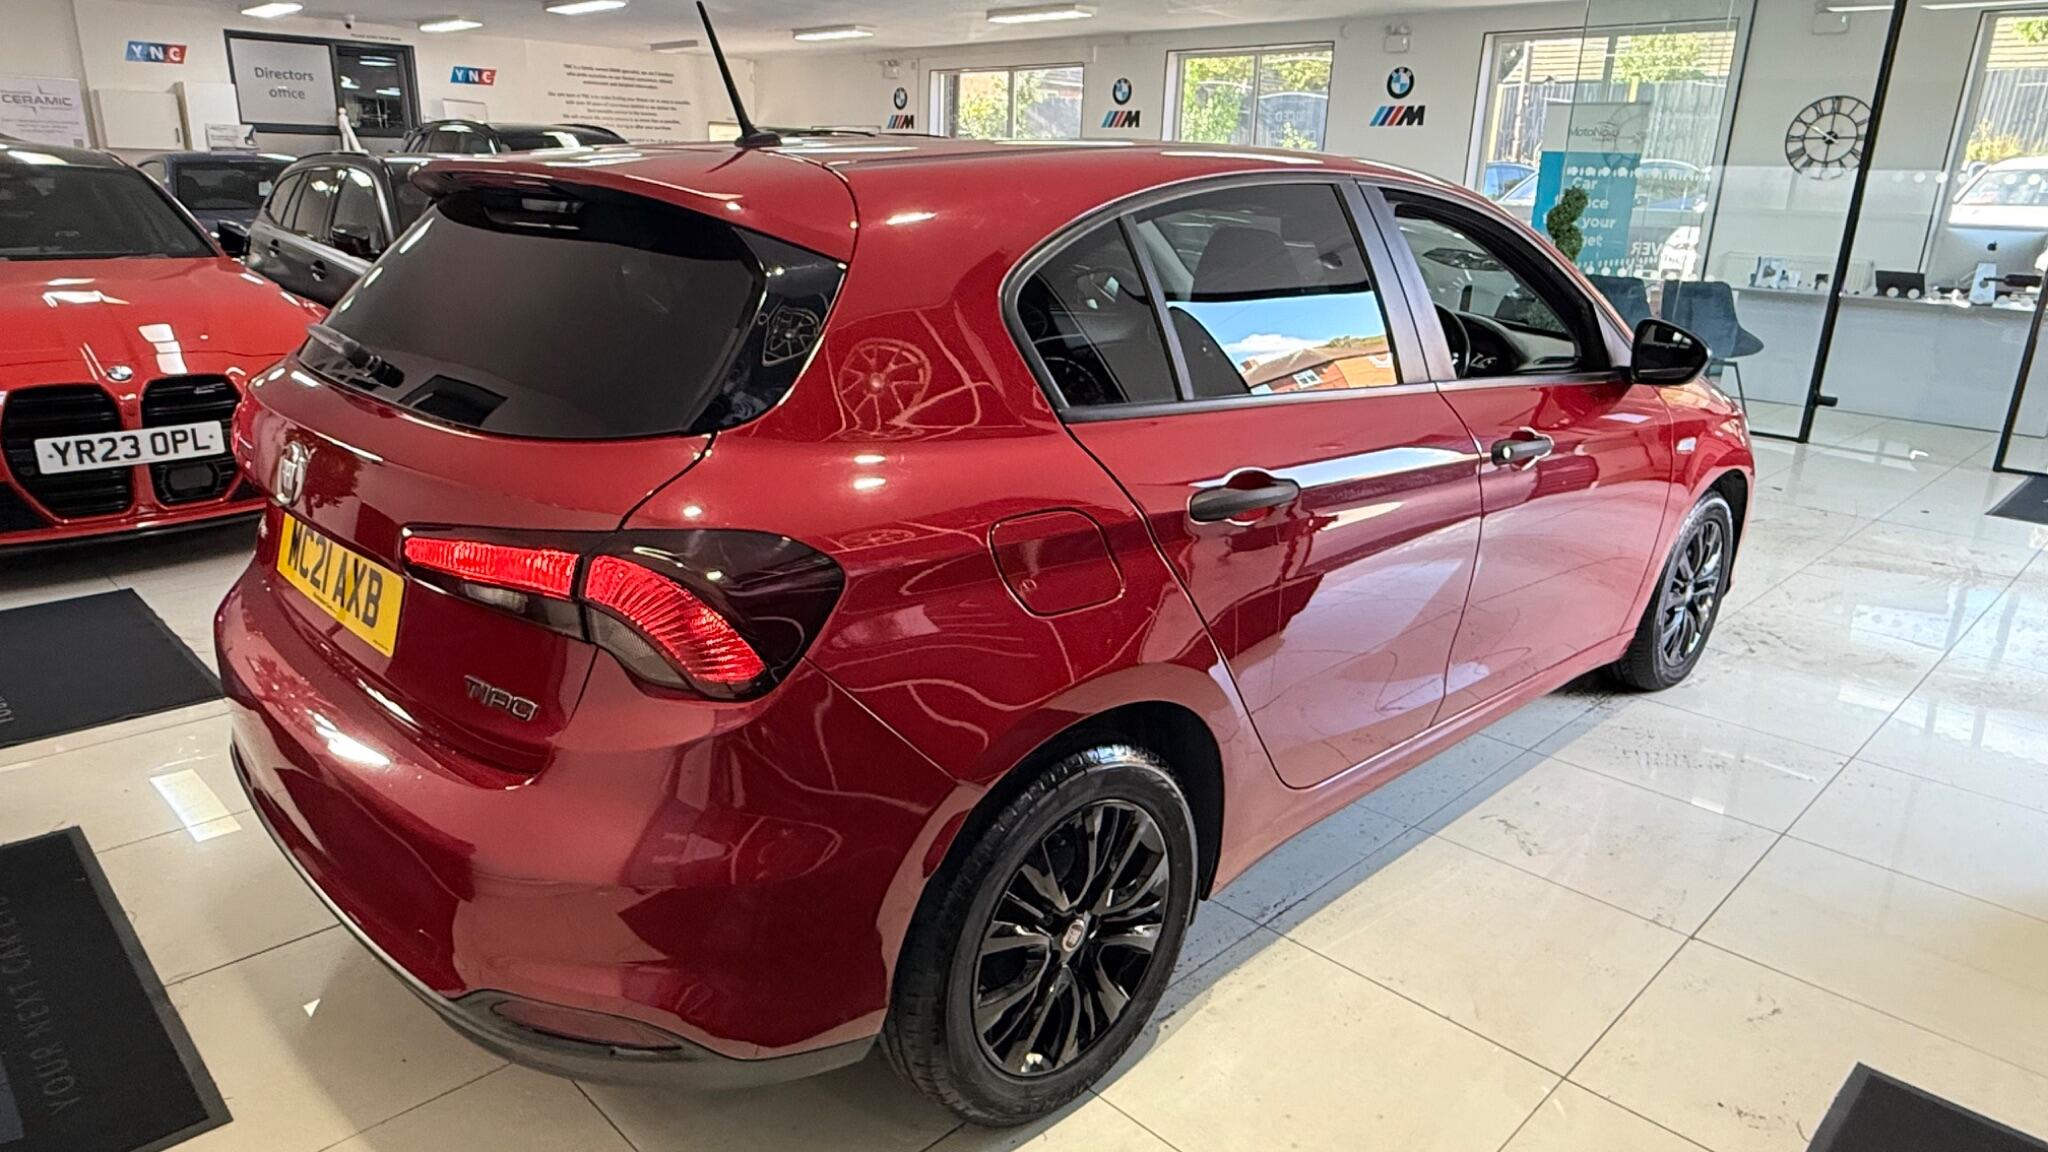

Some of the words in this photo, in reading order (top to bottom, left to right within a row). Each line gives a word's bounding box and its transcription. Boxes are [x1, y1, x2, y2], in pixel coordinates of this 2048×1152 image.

[129, 43, 183, 62] YNC
[254, 66, 314, 82] Directors
[454, 68, 493, 84] YNC
[1, 94, 73, 107] CERAMIC
[1572, 177, 1598, 190] Car
[1582, 216, 1617, 229] your
[51, 434, 140, 467] YR23
[150, 427, 211, 456] OPL
[288, 518, 333, 594] MC21
[332, 551, 384, 629] AXB
[464, 674, 540, 721] TIPO
[8, 979, 55, 1038] NEXT
